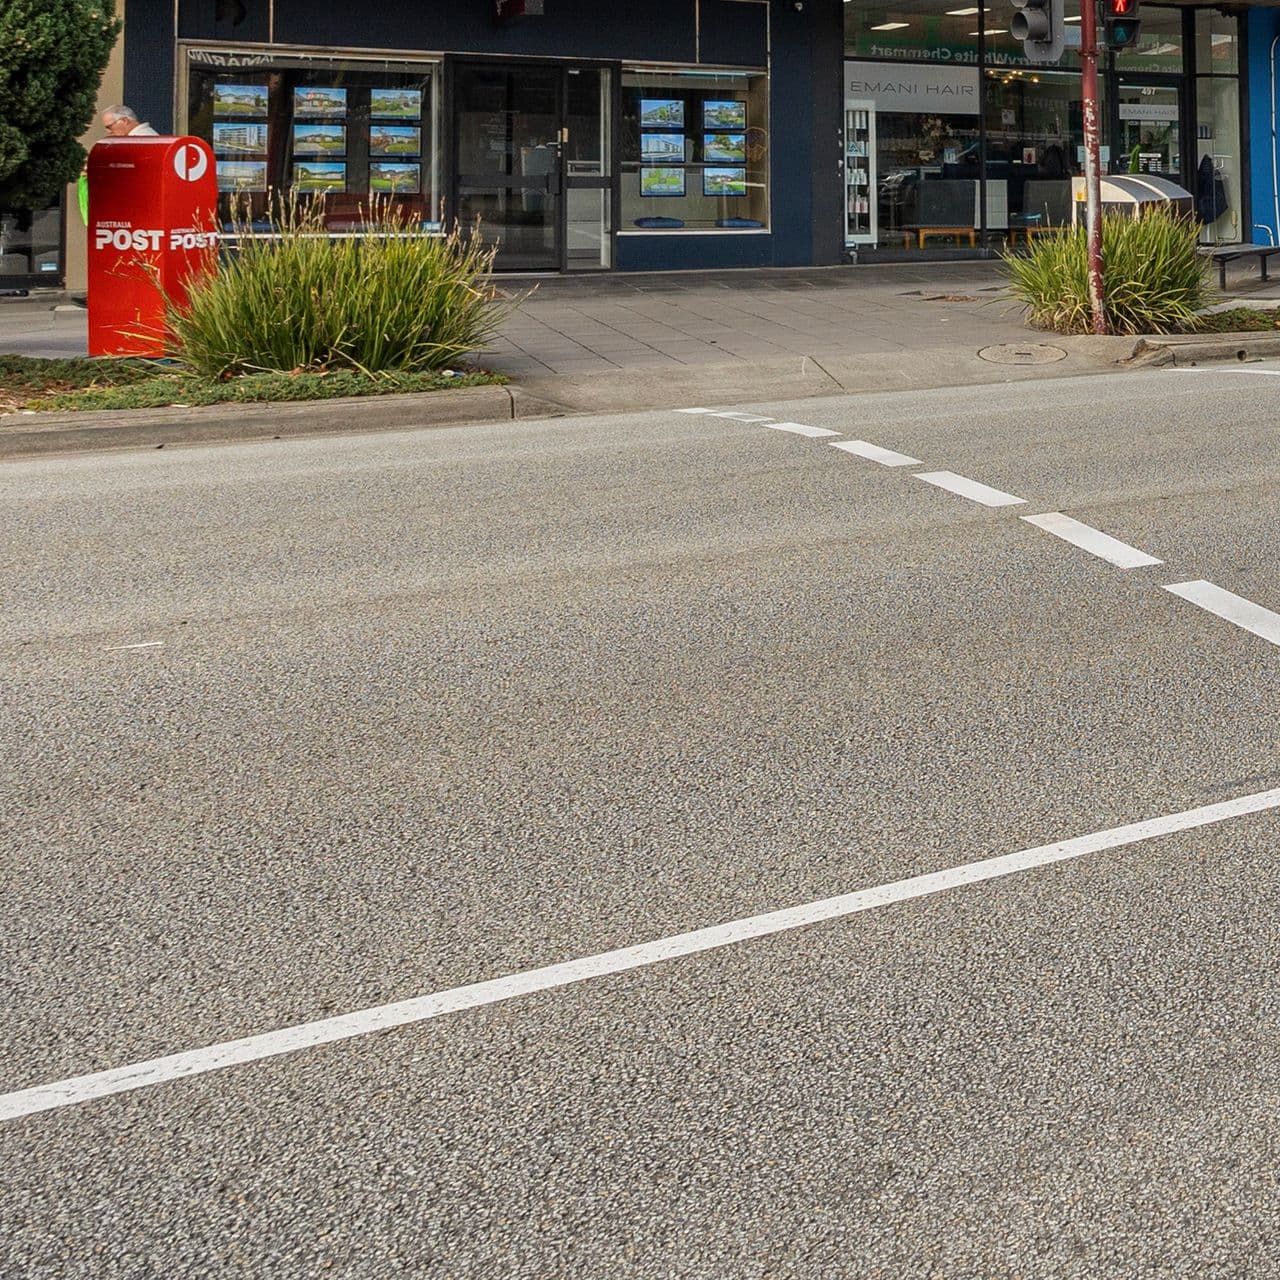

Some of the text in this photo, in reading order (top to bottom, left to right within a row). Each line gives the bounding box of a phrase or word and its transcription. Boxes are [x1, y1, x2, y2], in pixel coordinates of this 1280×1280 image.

[850, 81, 974, 96] EMANI HAIR
[96, 221, 132, 229] AUSTRALIA
[95, 228, 165, 252] POST
[170, 231, 219, 251] POST
